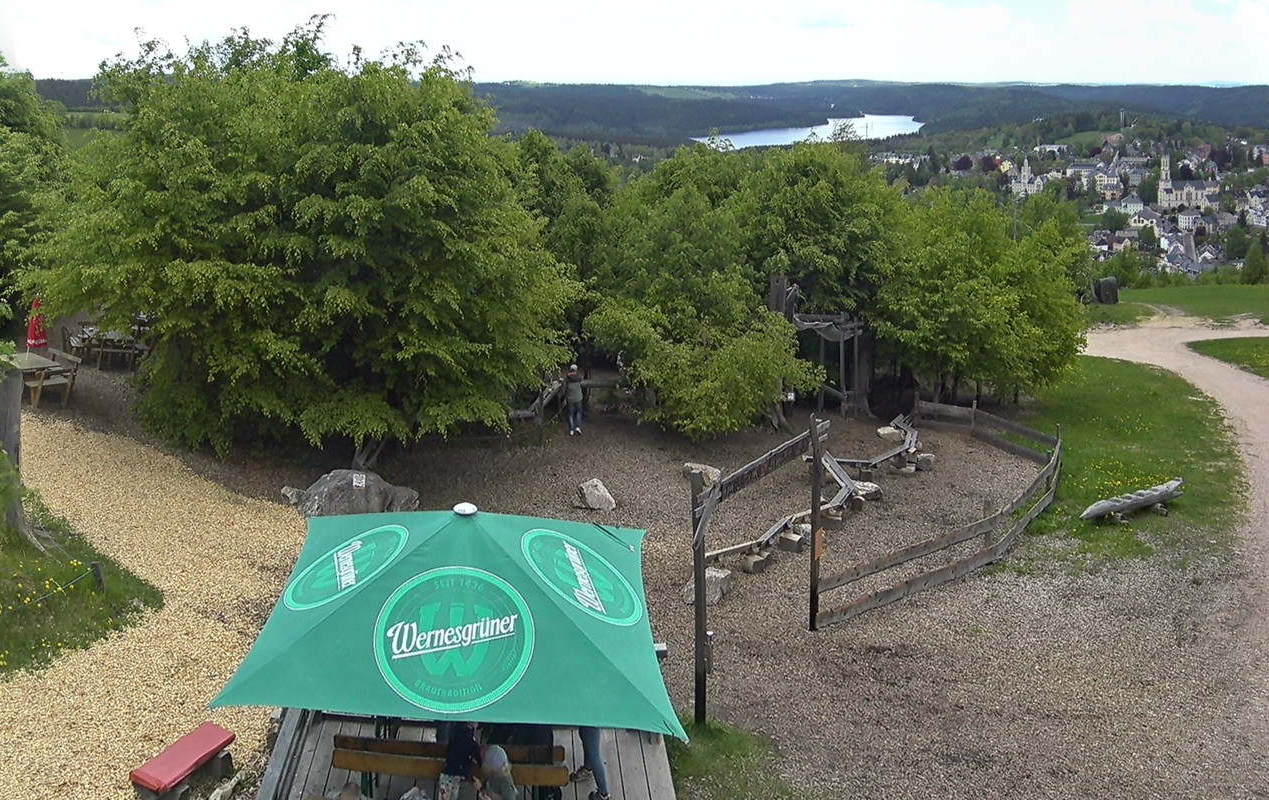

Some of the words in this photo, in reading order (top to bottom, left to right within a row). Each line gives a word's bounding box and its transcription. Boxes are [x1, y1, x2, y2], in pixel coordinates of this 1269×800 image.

[434, 578, 455, 590] SEIT
[460, 578, 484, 591] 1436
[386, 613, 518, 655] Wernesgrüner
[414, 678, 483, 698] BRAUTRADITION
